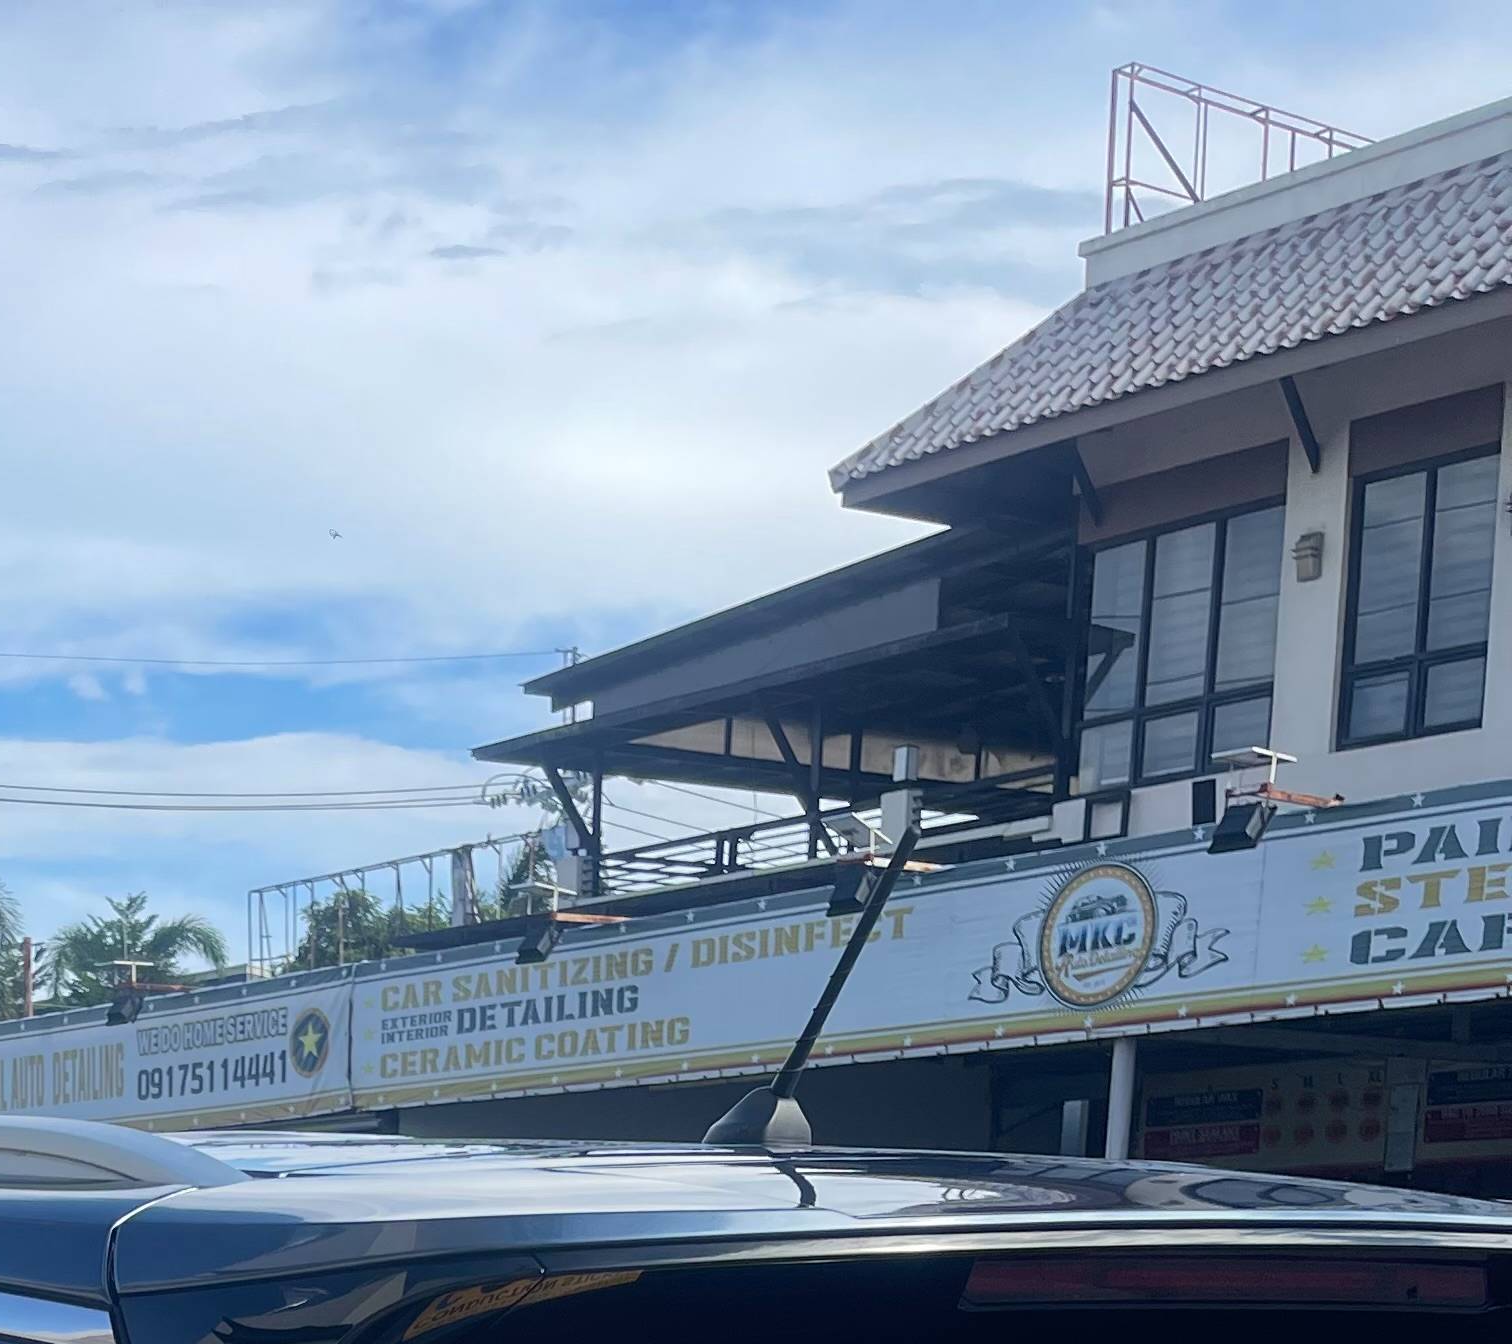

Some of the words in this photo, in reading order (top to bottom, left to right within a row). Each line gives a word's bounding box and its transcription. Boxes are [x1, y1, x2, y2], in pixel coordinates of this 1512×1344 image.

[1358, 816, 1512, 871] PAI
[381, 980, 443, 1012] CAR
[451, 948, 654, 1003] SANITIZING
[137, 1029, 160, 1057] WE
[160, 1024, 181, 1053] DO
[182, 1017, 224, 1050] HOME
[224, 1007, 288, 1044] SERVICE
[381, 1010, 453, 1031] EXTERIOR
[381, 1026, 449, 1045] INTERIOR
[456, 985, 640, 1035] DETAILING
[380, 1036, 526, 1079] CERAMIC
[535, 1016, 691, 1062] COATING
[11, 1054, 45, 1110] AUTO
[53, 1042, 125, 1106] DETAILING
[137, 1050, 287, 1101] 09175114441
